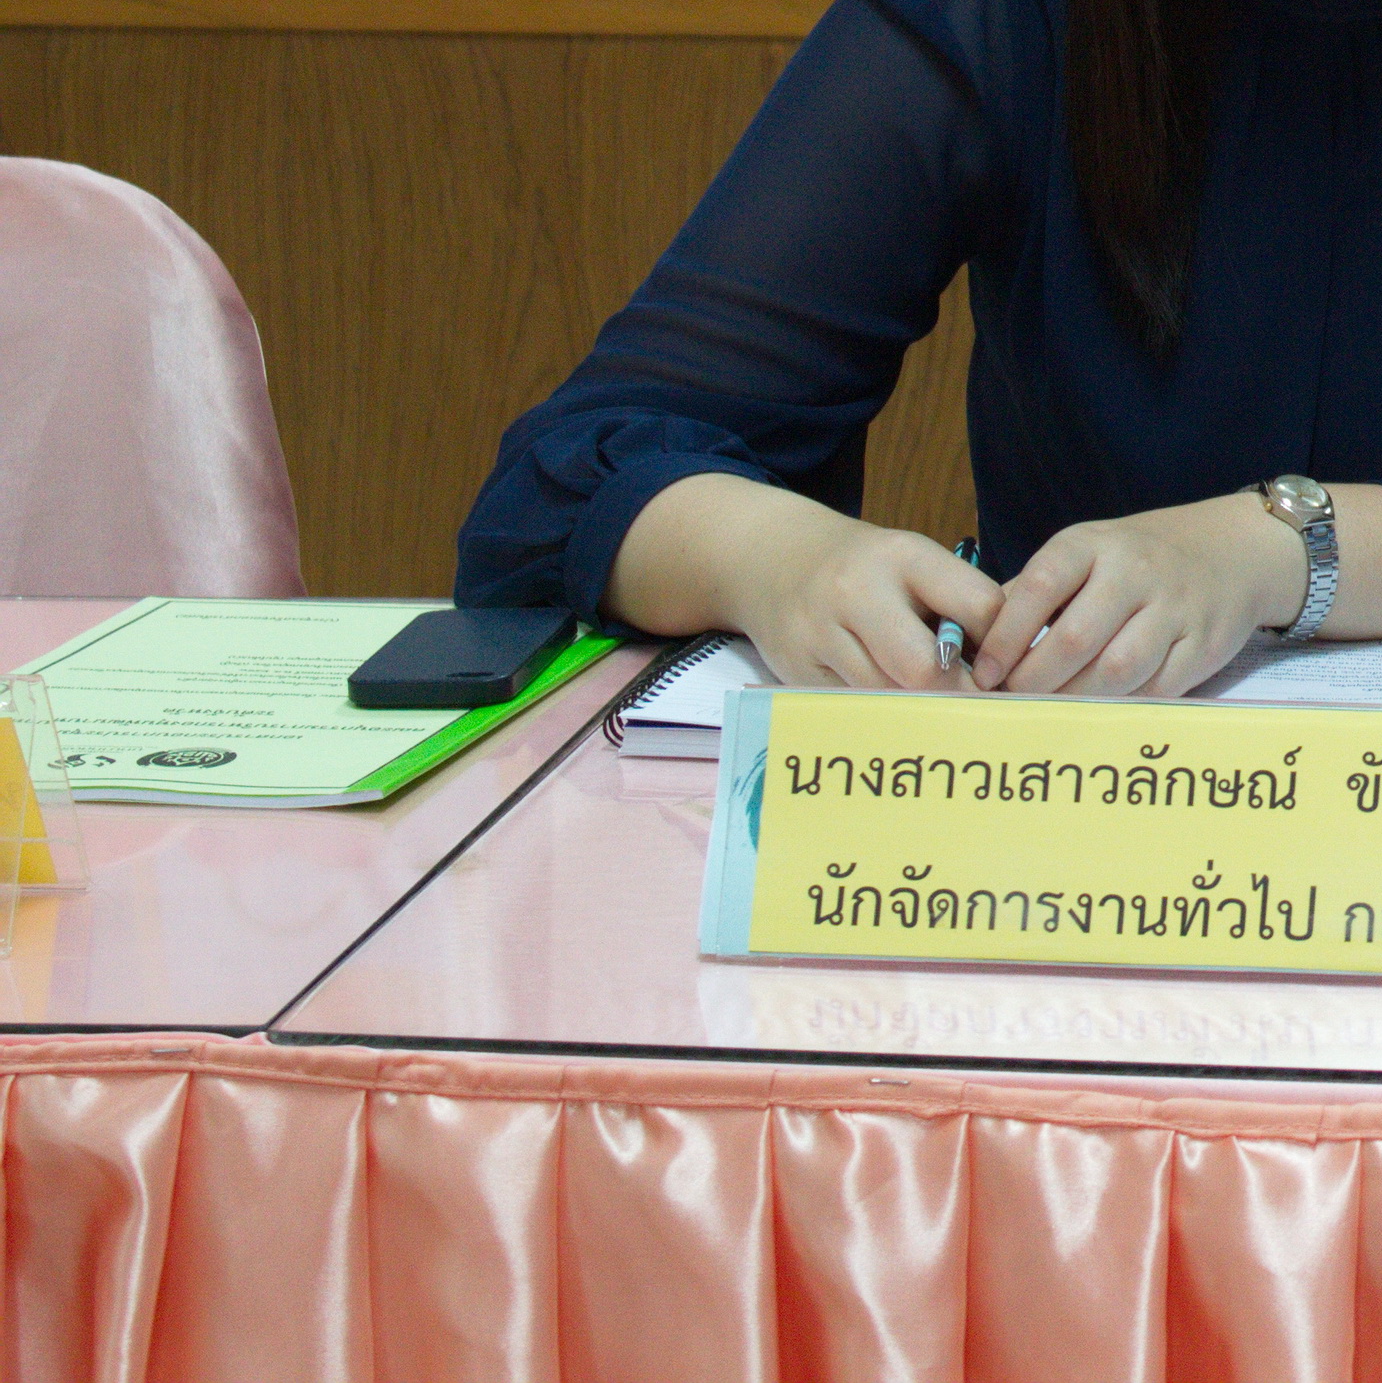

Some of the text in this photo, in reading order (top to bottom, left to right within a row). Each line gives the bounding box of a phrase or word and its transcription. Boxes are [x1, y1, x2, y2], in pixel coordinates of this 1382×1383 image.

[785, 744, 1302, 812] นางสาวเสาวลักษณ์
[807, 859, 1313, 942] นักจัดการงานทั่วไป
